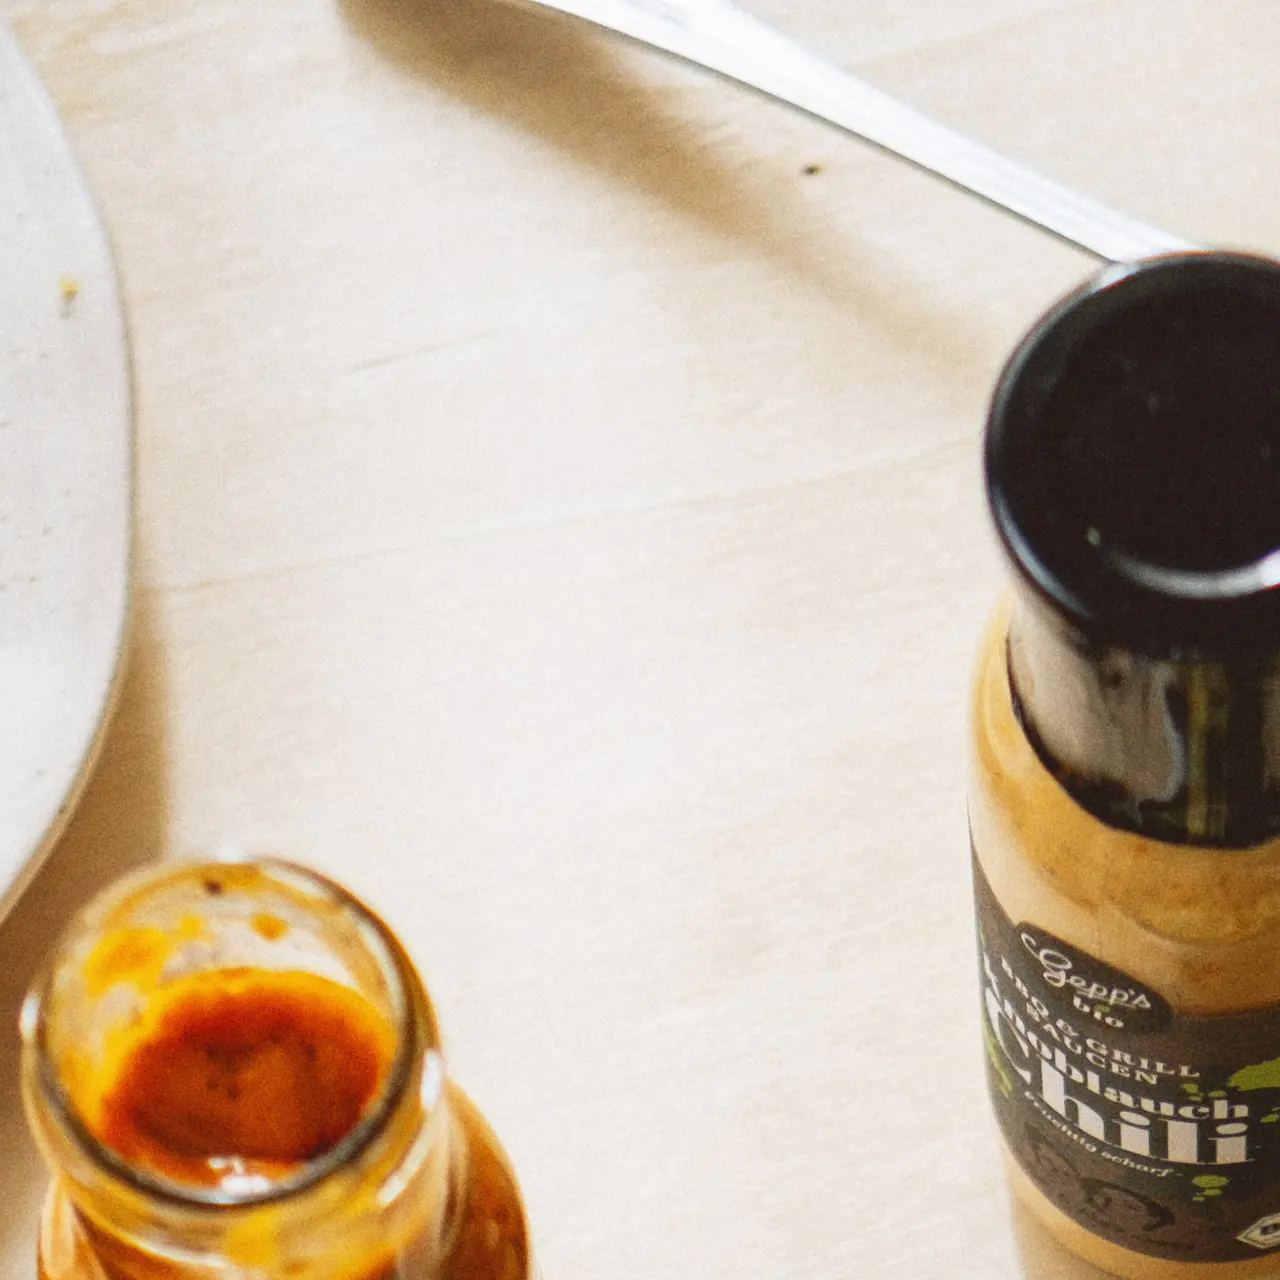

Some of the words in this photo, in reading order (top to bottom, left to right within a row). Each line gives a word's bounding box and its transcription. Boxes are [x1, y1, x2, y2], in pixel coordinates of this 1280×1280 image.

[1073, 995, 1124, 1028] bio
[1026, 1002, 1158, 1085] SAUCEN
[1086, 1037, 1200, 1078] GRILL
[985, 986, 1256, 1165] Chili
